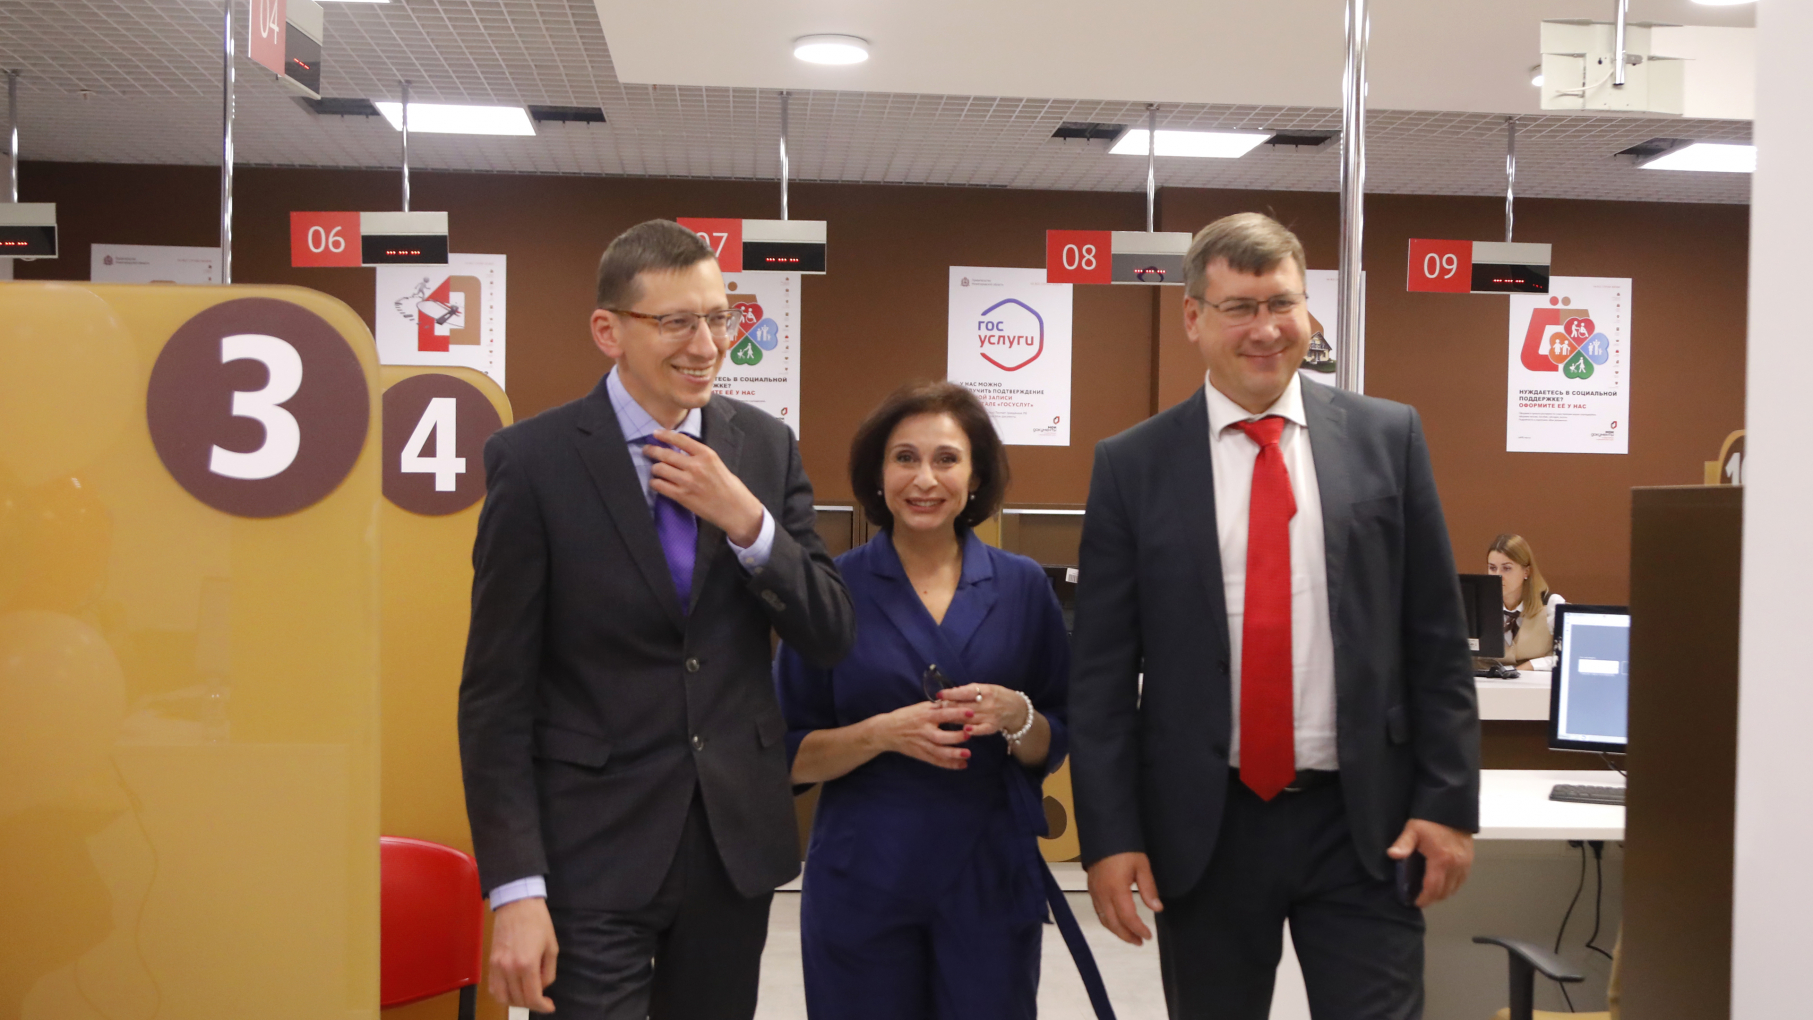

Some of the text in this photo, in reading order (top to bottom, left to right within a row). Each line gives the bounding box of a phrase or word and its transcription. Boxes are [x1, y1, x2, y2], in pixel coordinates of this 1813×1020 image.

[260, 0, 279, 44] 04
[307, 225, 346, 253] 06
[1062, 243, 1097, 270] 08
[1423, 252, 1458, 279] 09
[992, 388, 1045, 396] ПОДТВЕРЖДЕНИЕ
[209, 333, 303, 480] 3
[401, 397, 467, 492] 4
